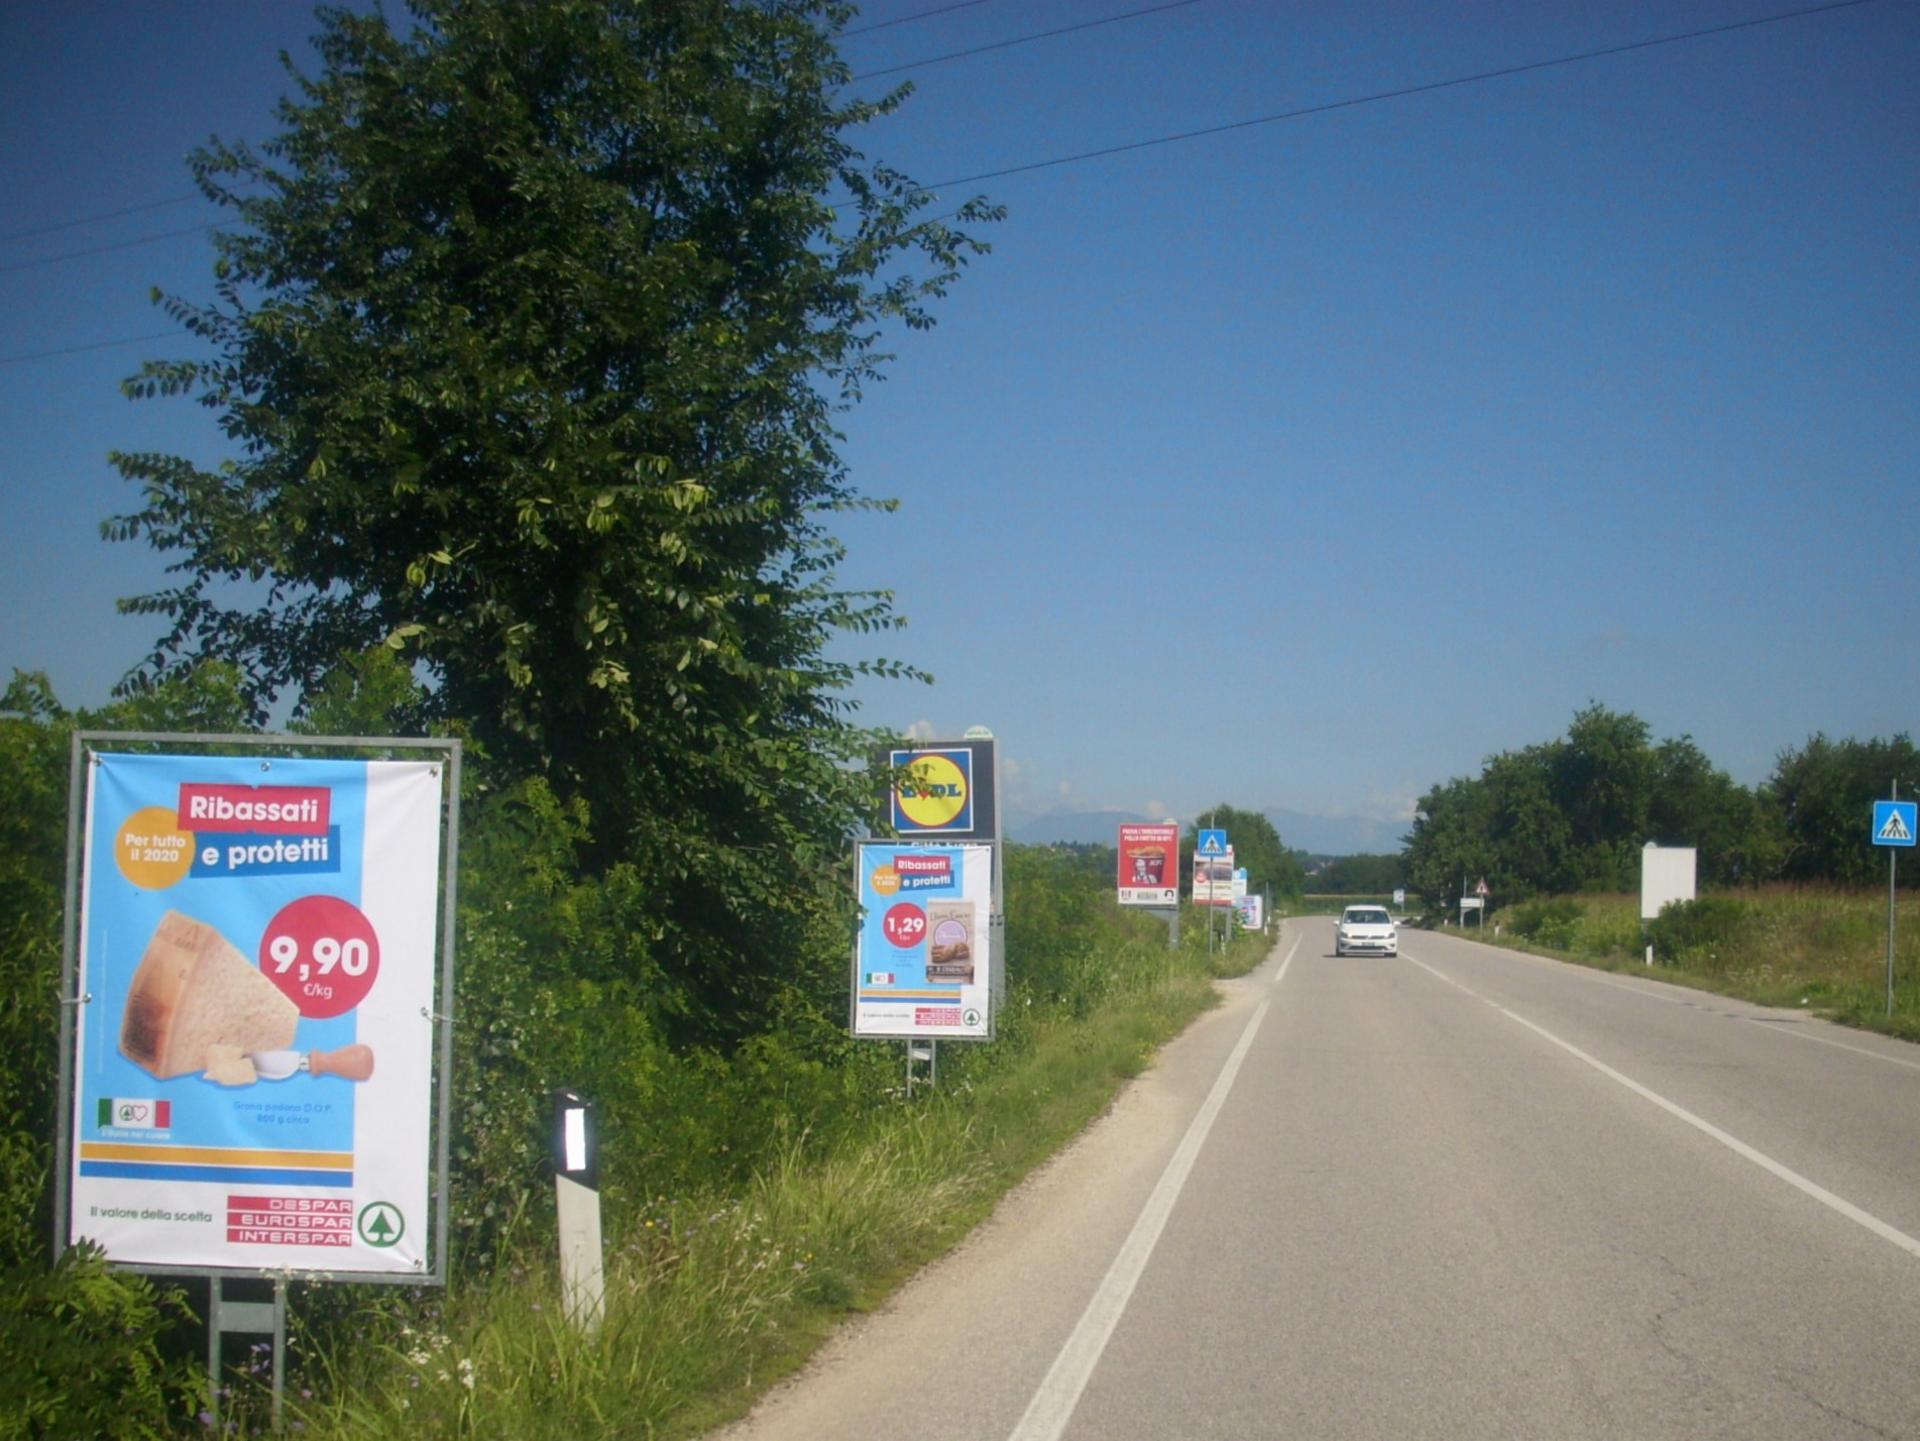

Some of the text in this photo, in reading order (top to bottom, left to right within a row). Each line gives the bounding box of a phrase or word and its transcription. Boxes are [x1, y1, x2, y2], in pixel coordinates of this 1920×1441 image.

[190, 795, 318, 822] Ribassati
[125, 833, 186, 848] Per tutto
[144, 848, 179, 862] 2020
[202, 838, 328, 869] e protetti
[898, 860, 946, 870] Ribassati
[903, 878, 910, 887] e
[913, 875, 951, 888] protetti
[888, 917, 924, 935] 1,29
[269, 935, 369, 982] 9,90
[303, 983, 333, 999] €/kg
[269, 1199, 352, 1212] DESPAR
[100, 1207, 138, 1219] valore
[141, 1209, 172, 1221] della
[174, 1211, 212, 1222] scelta
[241, 1214, 352, 1229] EUROSPAR
[239, 1230, 351, 1246] INTERSPAR
